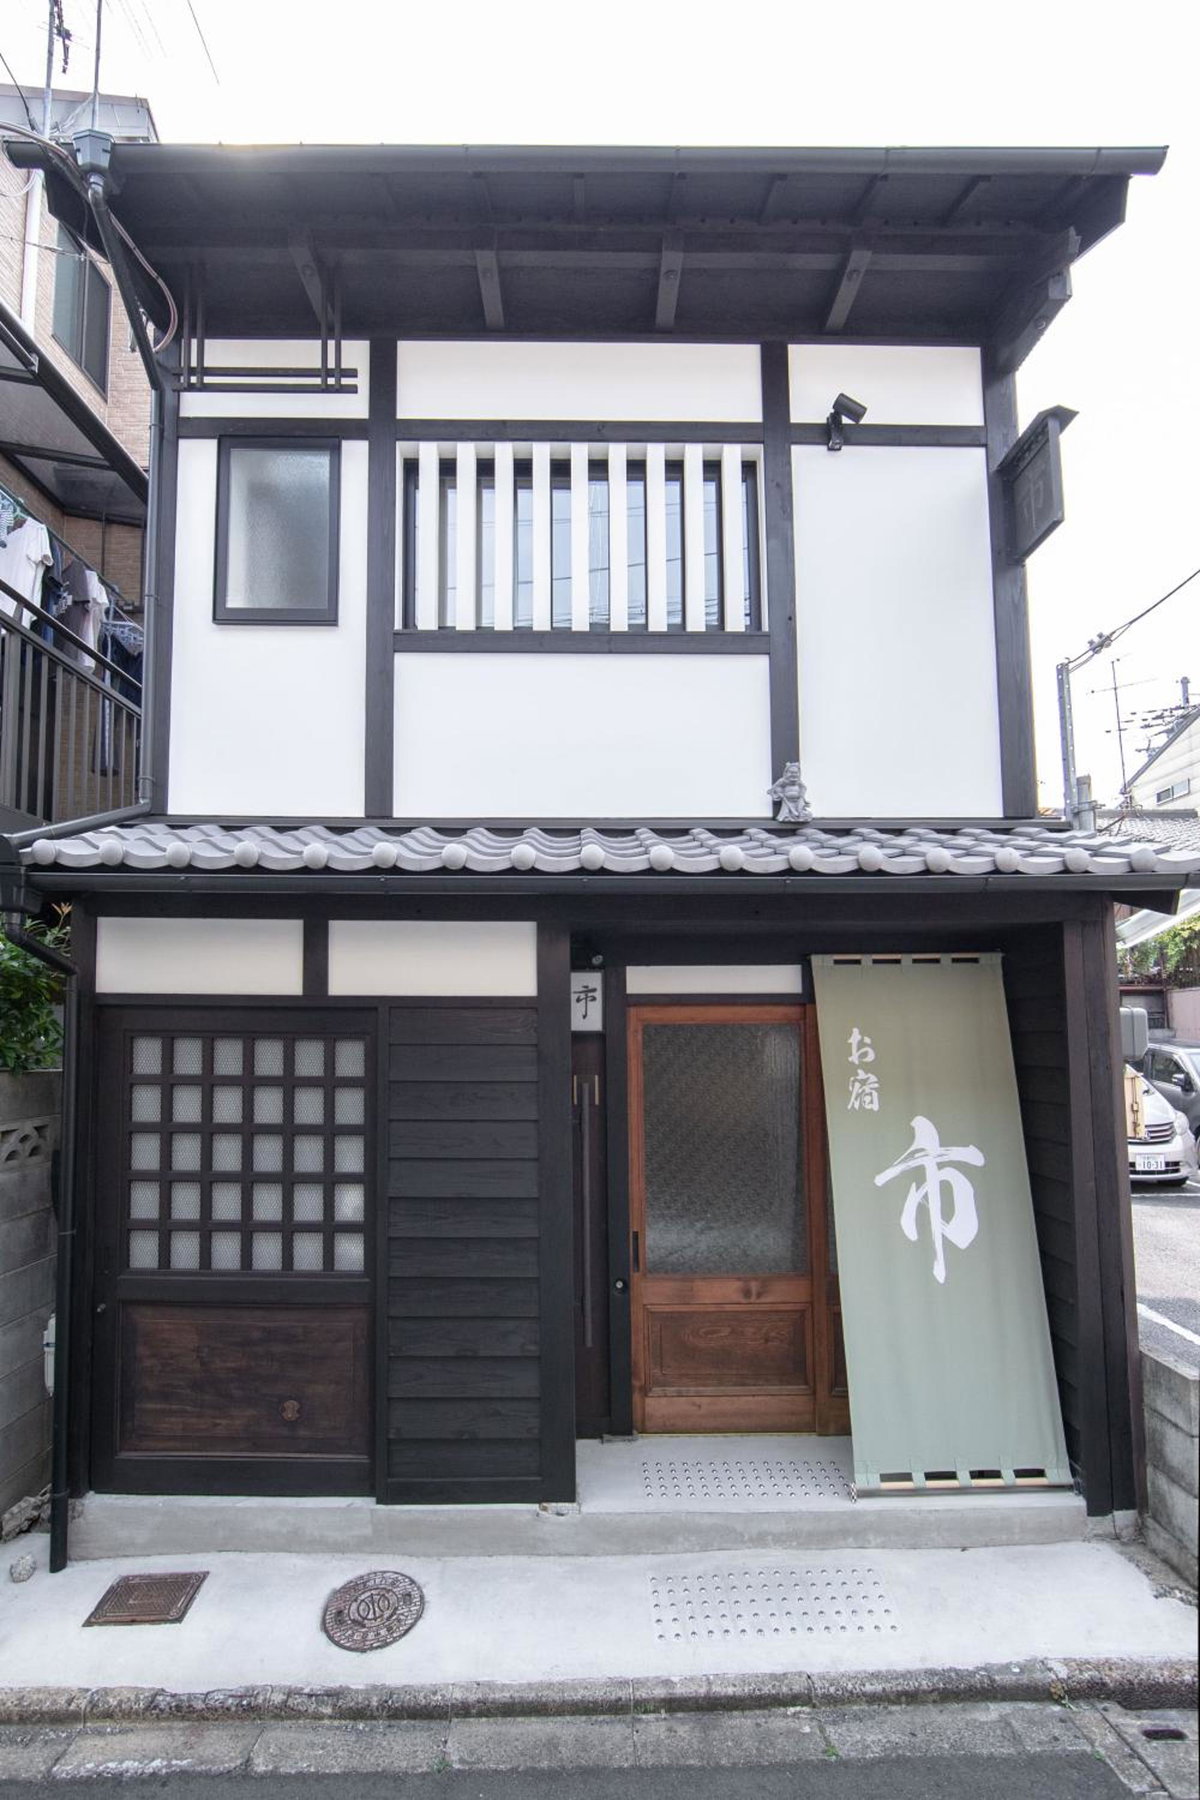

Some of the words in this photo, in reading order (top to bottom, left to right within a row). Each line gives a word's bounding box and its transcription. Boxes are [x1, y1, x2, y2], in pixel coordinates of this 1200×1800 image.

[572, 985, 598, 1020] 市
[847, 1027, 881, 1113] お宿
[874, 1115, 986, 1285] 市
